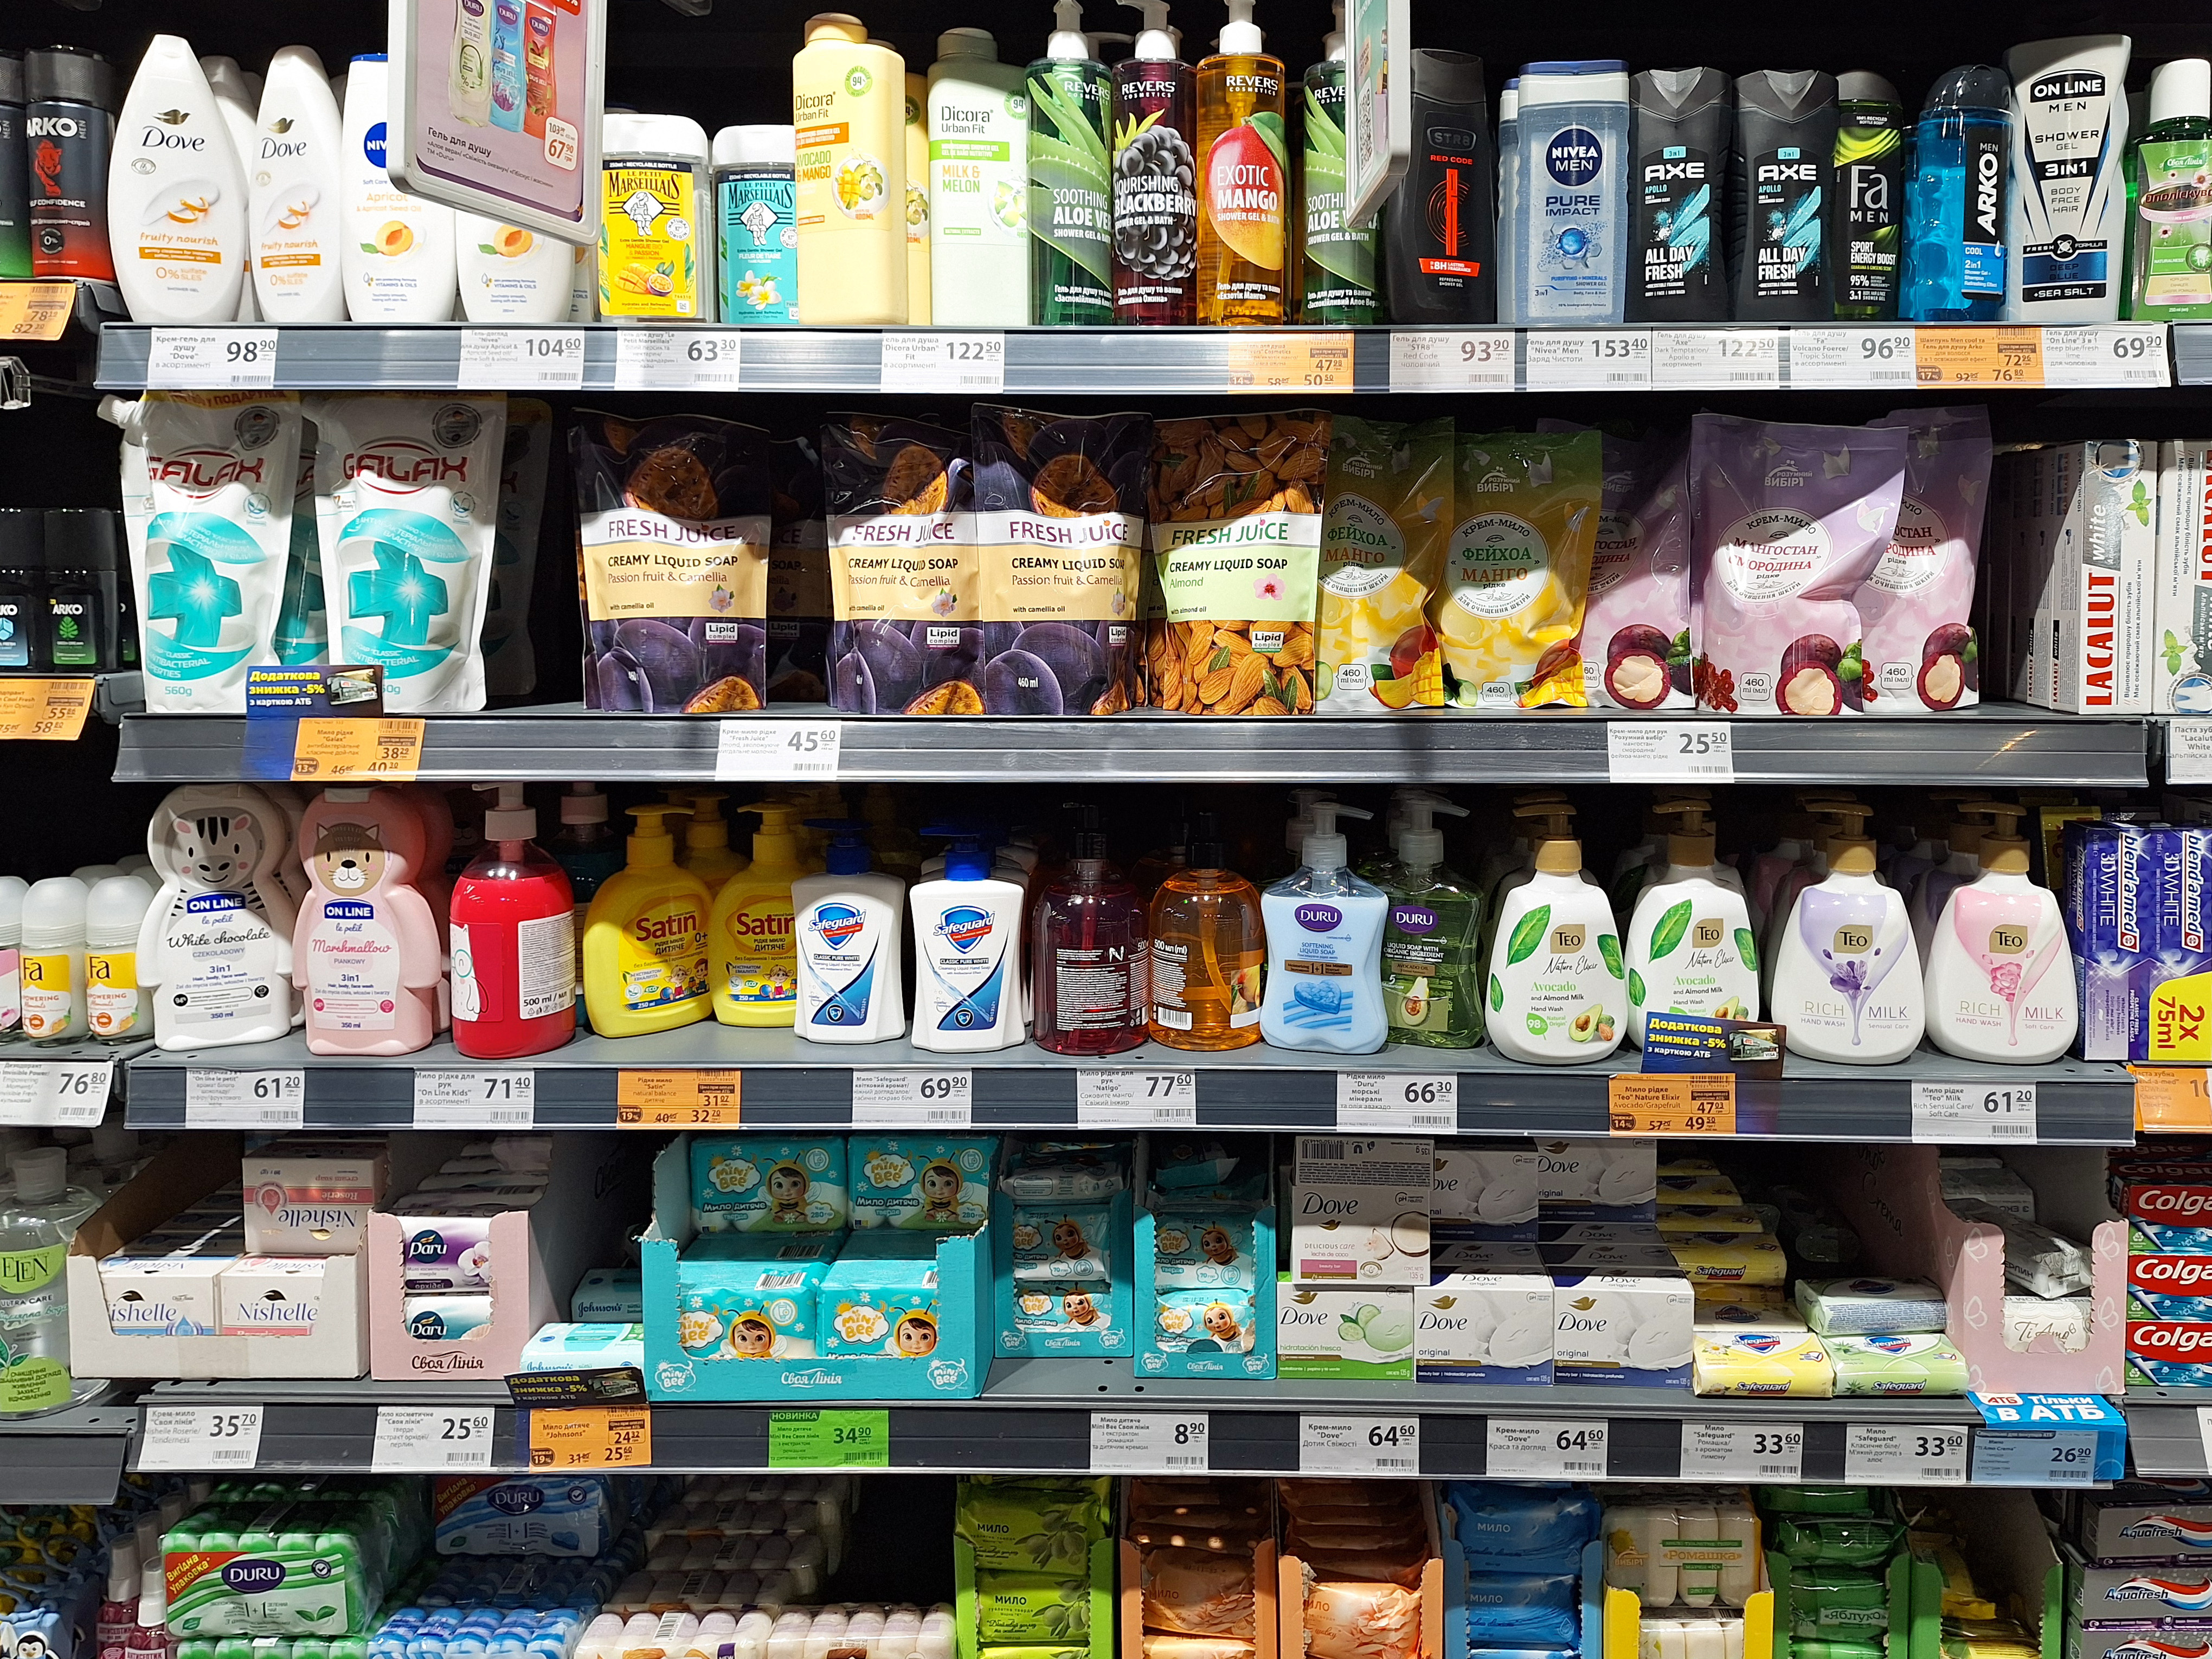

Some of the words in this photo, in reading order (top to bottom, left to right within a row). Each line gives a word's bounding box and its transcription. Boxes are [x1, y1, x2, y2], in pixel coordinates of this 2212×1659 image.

[1122, 81, 1174, 94] REVERS
[1226, 75, 1277, 90] REVERS
[2034, 83, 2060, 98] ON
[2064, 80, 2102, 95] LINE
[796, 92, 833, 110] Dicora
[2049, 101, 2087, 113] MEN
[796, 111, 816, 122] Urban
[818, 108, 828, 118] Fit
[142, 126, 205, 151] Dove
[428, 127, 448, 141] Гель
[450, 133, 466, 147] для
[468, 140, 492, 157] душу
[2035, 130, 2099, 143] SHOWER
[261, 138, 307, 159] Dove
[549, 138, 565, 160] 67
[565, 144, 574, 154] 90
[1552, 146, 1598, 158] NIVEA
[1979, 142, 1998, 152] MEN
[2056, 142, 2078, 151] GEL
[796, 150, 831, 168] AVOCADO
[1450, 157, 1472, 165] CODE
[1555, 159, 1593, 172] MEN
[943, 165, 969, 178] MILK
[972, 164, 980, 177] &
[1218, 165, 1269, 187] EXOTIC
[1645, 163, 1705, 182] AXE
[608, 172, 680, 199] MARSEILLAIS
[943, 179, 980, 193] MELON
[1115, 176, 1179, 194] NOURISHING
[1645, 185, 1667, 194] APOLLO
[1850, 165, 1888, 209] Fa
[1053, 189, 1108, 208] SOOTHING
[1217, 189, 1277, 210] MANGO
[1545, 195, 1600, 208] PURE
[1978, 153, 1998, 236] ARKO
[1545, 208, 1600, 217] IMPACT
[1850, 211, 1888, 223] MEN
[140, 233, 173, 245] fruity
[177, 235, 218, 246] nourish
[1645, 249, 1668, 264] ALL
[1669, 246, 1694, 262] DAY
[1851, 242, 1874, 253] SPORT
[1965, 247, 1983, 255] COOL
[1850, 253, 1876, 265] ENERGY
[1877, 254, 1896, 266] BOOST
[1645, 264, 1683, 281] FRESH
[1850, 275, 1869, 286] 95%
[2065, 287, 2094, 296] SALT
[156, 336, 198, 345] Крем-гель
[1429, 336, 1449, 344] душу
[227, 342, 258, 362] 98
[260, 340, 275, 350] 90
[1461, 341, 1491, 362] 93
[1493, 340, 1509, 349] 90
[343, 455, 468, 482] GALAX
[1009, 522, 1071, 543] FRESH
[2089, 504, 2107, 561] white
[1462, 545, 1532, 561] ФЕЙХОА
[1012, 558, 1058, 569] CREAMY
[1063, 558, 1106, 571] LIQUID
[1169, 561, 1211, 573] CREAMY
[1214, 559, 1253, 570] LIQUID
[1257, 558, 1288, 569] SOAP
[1169, 577, 1203, 588] Almond
[1462, 568, 1528, 582] МАНГО
[1255, 633, 1281, 642] Lipid
[2086, 573, 2114, 705] LACALUT
[250, 671, 320, 682] Додаткова
[249, 684, 299, 695] знижка
[303, 684, 325, 693] -5%
[1487, 686, 1504, 695] 460
[788, 731, 818, 751] 45
[820, 730, 835, 740] 60
[1680, 734, 1709, 754] 25
[1712, 733, 1727, 742] 50
[190, 901, 211, 910] ON
[214, 898, 242, 908] LINE
[1301, 909, 1338, 922] DURU
[636, 914, 696, 942] Satin
[934, 911, 995, 936] Safeguard
[167, 931, 211, 949] White
[214, 928, 271, 943] chocolate
[312, 939, 392, 953] Marshmallow
[754, 944, 785, 952] ДИТЯЧЕ
[1531, 981, 1576, 992] Avocado
[1805, 1000, 1844, 1017] RICH
[1869, 1006, 1908, 1019] MILK
[2157, 996, 2176, 1049] 75ml
[921, 1078, 951, 1098] 69
[952, 1077, 967, 1086] 90
[1405, 1083, 1435, 1103] 66
[1437, 1082, 1452, 1091] 30
[1984, 1092, 2012, 1113] 61
[2016, 1091, 2032, 1100] 20
[856, 1199, 883, 1207] Мило
[887, 1198, 918, 1207] дитяче
[1302, 1192, 1359, 1214] Dove
[237, 1302, 317, 1321] Nishelle
[1558, 1313, 1607, 1332] Dove
[1557, 1349, 1589, 1358] original
[412, 1356, 447, 1370] Своя
[451, 1354, 484, 1369] Лінія
[1736, 1379, 1791, 1392] Safeguard
[2030, 1405, 2105, 1420] АТБ
[210, 1416, 240, 1436] 35
[241, 1414, 256, 1424] 70
[1308, 1424, 1351, 1433] Крем-мило
[833, 1428, 857, 1444] 34
[858, 1427, 871, 1436] 90
[1368, 1426, 1399, 1446] 64
[1400, 1426, 1415, 1435] 60
[1303, 1440, 1324, 1448] Дотик
[1327, 1439, 1357, 1448] Свіжості
[1915, 1437, 1945, 1456] 33
[1947, 1436, 1963, 1445] 60
[2119, 1526, 2182, 1538] Aquafresh
[229, 1567, 280, 1583] DURU
